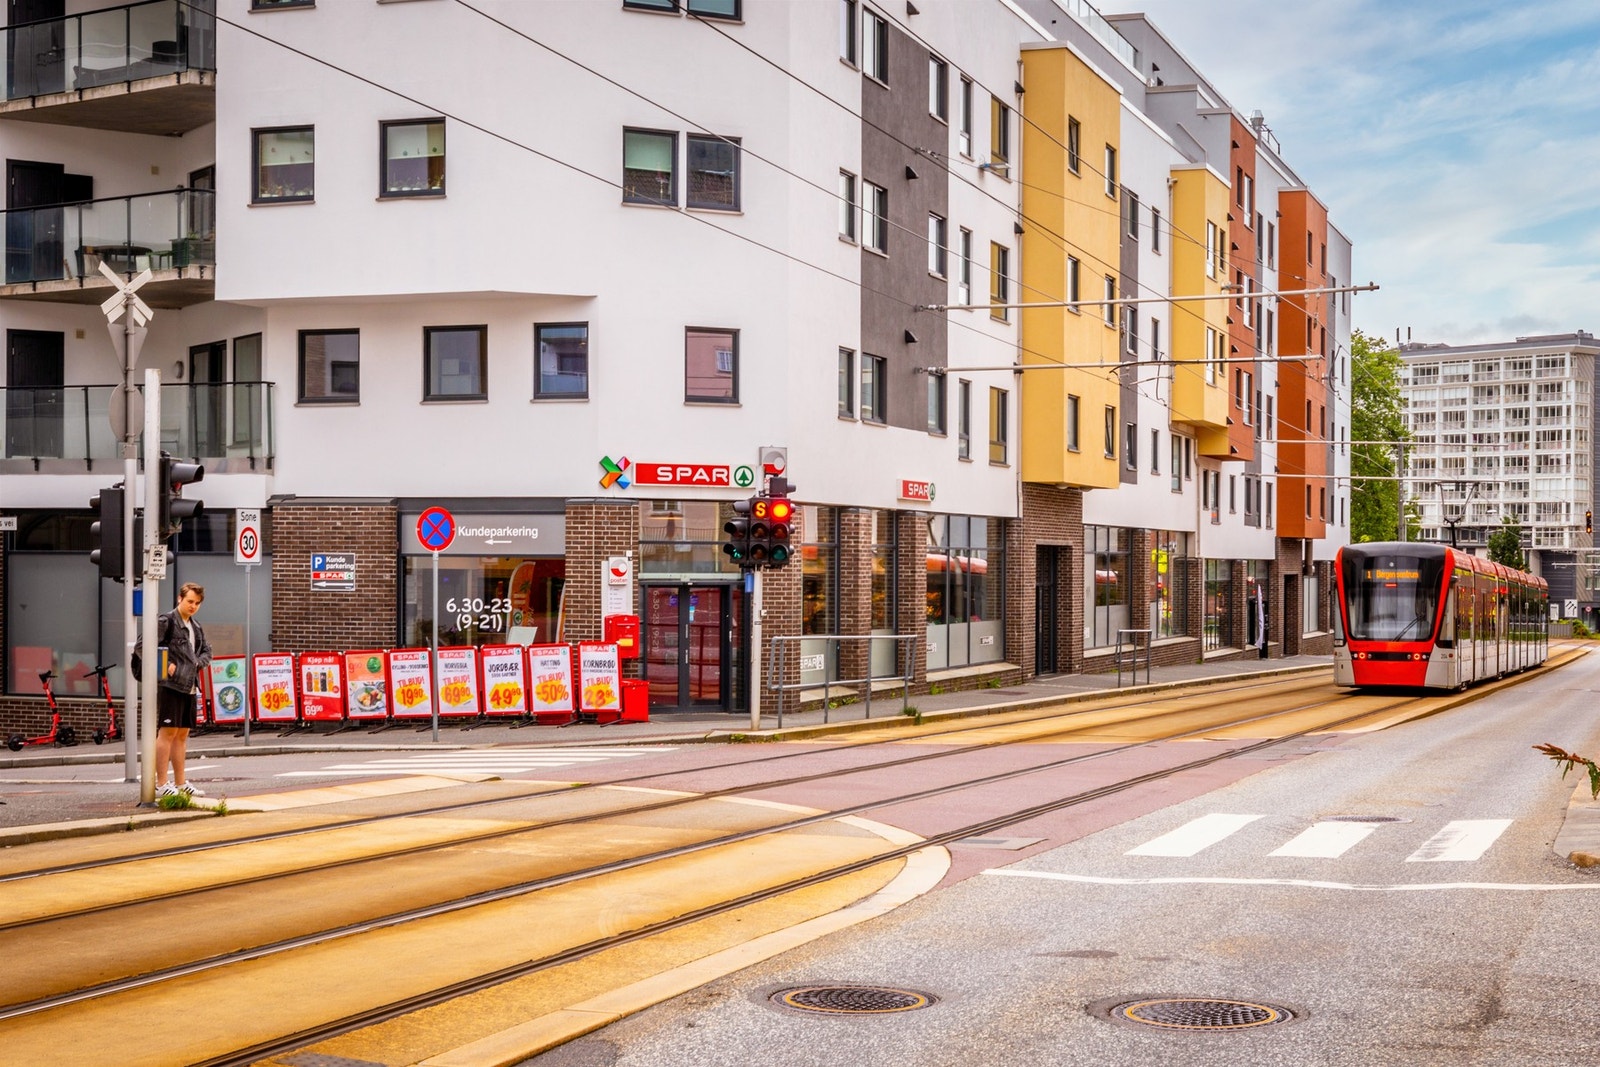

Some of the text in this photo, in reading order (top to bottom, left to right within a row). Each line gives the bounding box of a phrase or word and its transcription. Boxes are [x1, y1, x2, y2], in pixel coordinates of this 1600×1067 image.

[656, 466, 728, 483] SPAR
[908, 483, 928, 497] SPAR
[755, 502, 766, 517] S
[241, 511, 257, 522] Sone
[458, 526, 539, 539] Kundeparkering
[243, 535, 255, 551] 30
[314, 556, 323, 569] P
[325, 563, 354, 571] parkering
[1367, 570, 1372, 579] 1
[446, 598, 513, 613] 6.30-23
[456, 613, 503, 632] (9-21)
[307, 656, 322, 664] Kjøp
[583, 659, 616, 669] KORNBRØD
[488, 662, 519, 673] JORDBÆR
[397, 675, 425, 688] TILBUD!
[443, 674, 470, 686] TILBUD!
[537, 671, 566, 684] TILBUD!
[586, 675, 614, 687] TILBUD!
[262, 680, 289, 692] TILBUD!
[536, 684, 569, 703] -50%
